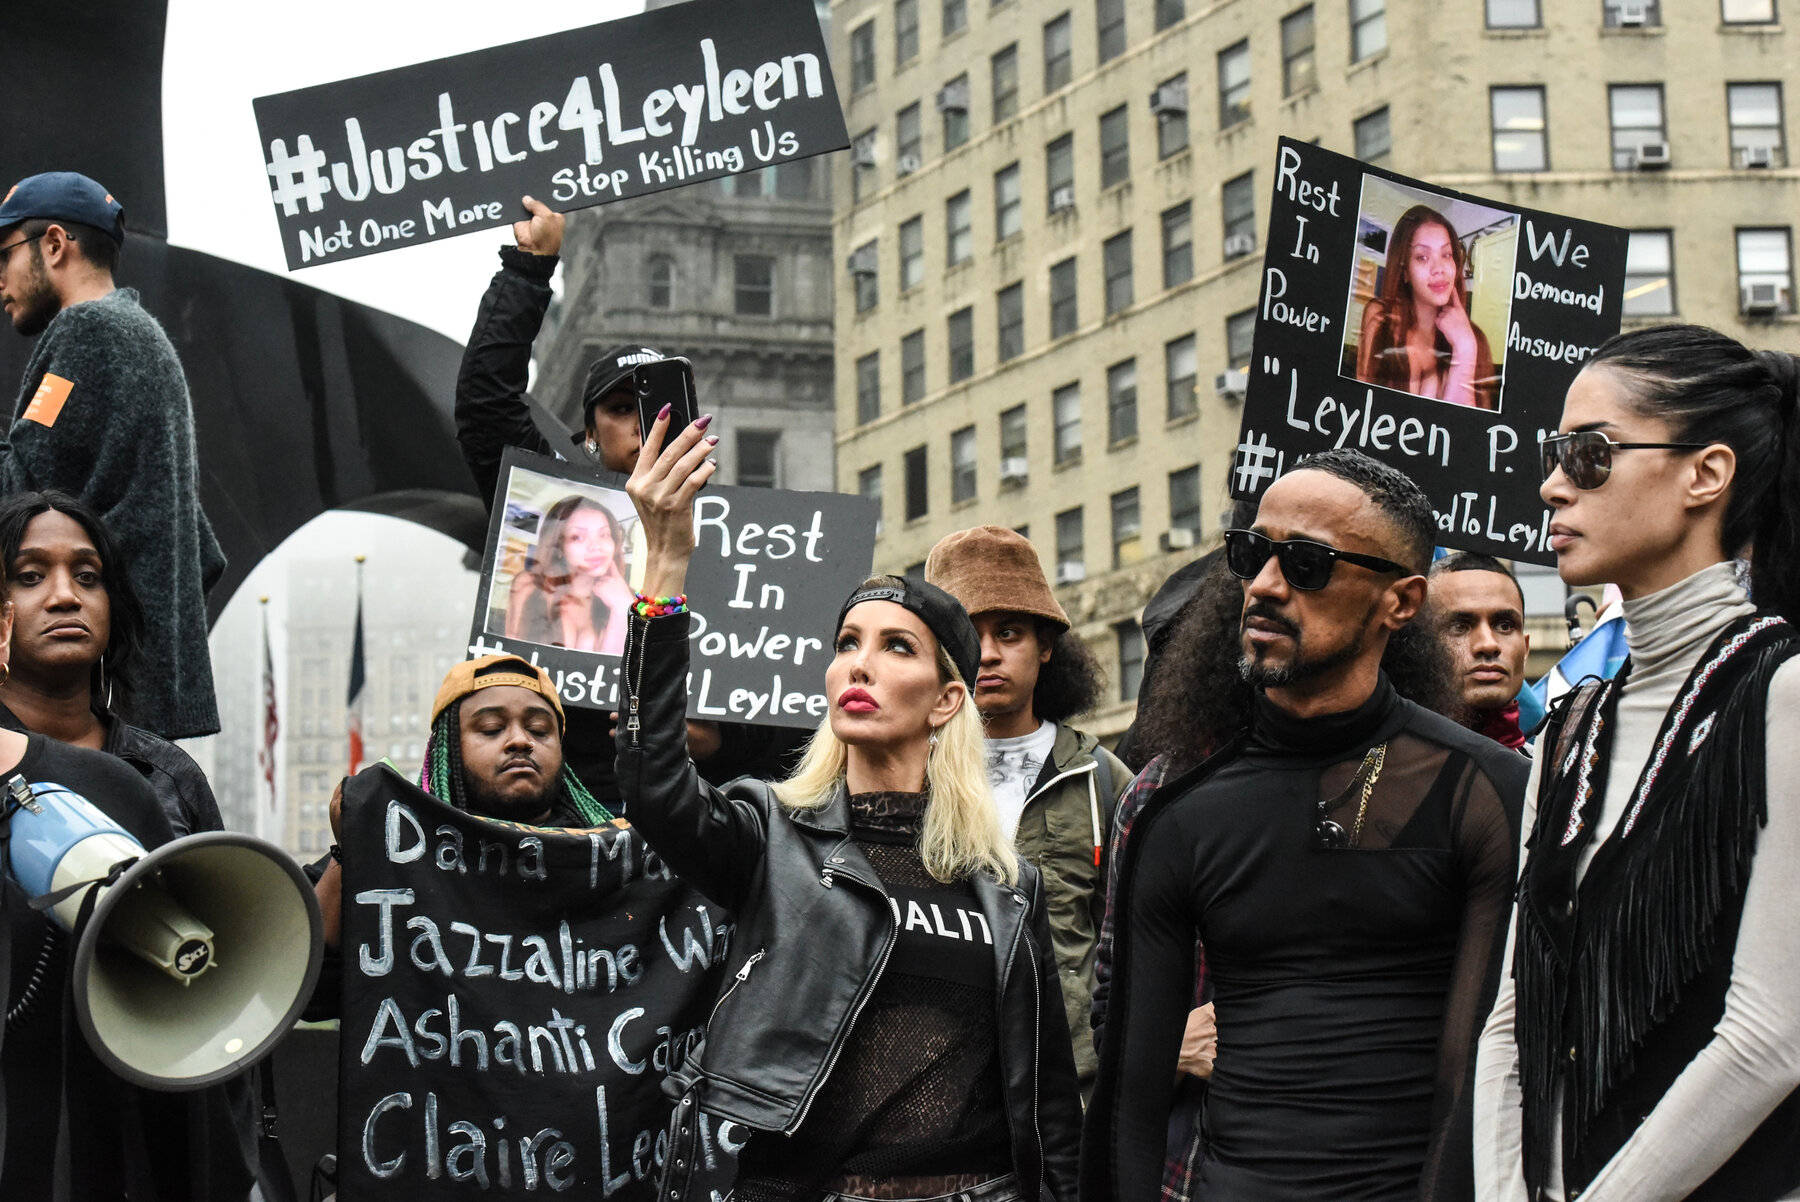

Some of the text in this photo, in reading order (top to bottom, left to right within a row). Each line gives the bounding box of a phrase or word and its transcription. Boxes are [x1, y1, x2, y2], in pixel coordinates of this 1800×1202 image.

[267, 38, 823, 217] #Justice4Leyleen
[552, 121, 799, 201] Stop Killing Us
[1276, 145, 1341, 218] Rest
[299, 197, 506, 263] Not One More
[1290, 214, 1320, 264] In
[1526, 219, 1590, 268] We
[1263, 266, 1331, 333] Power
[1514, 272, 1604, 315] Demand
[694, 496, 824, 562] Rest
[728, 563, 785, 610] In
[384, 799, 677, 889] Dana Ma
[355, 887, 645, 995] Jazzaline
[360, 993, 597, 1076] Ashanti
[362, 1091, 577, 1193] Claire
